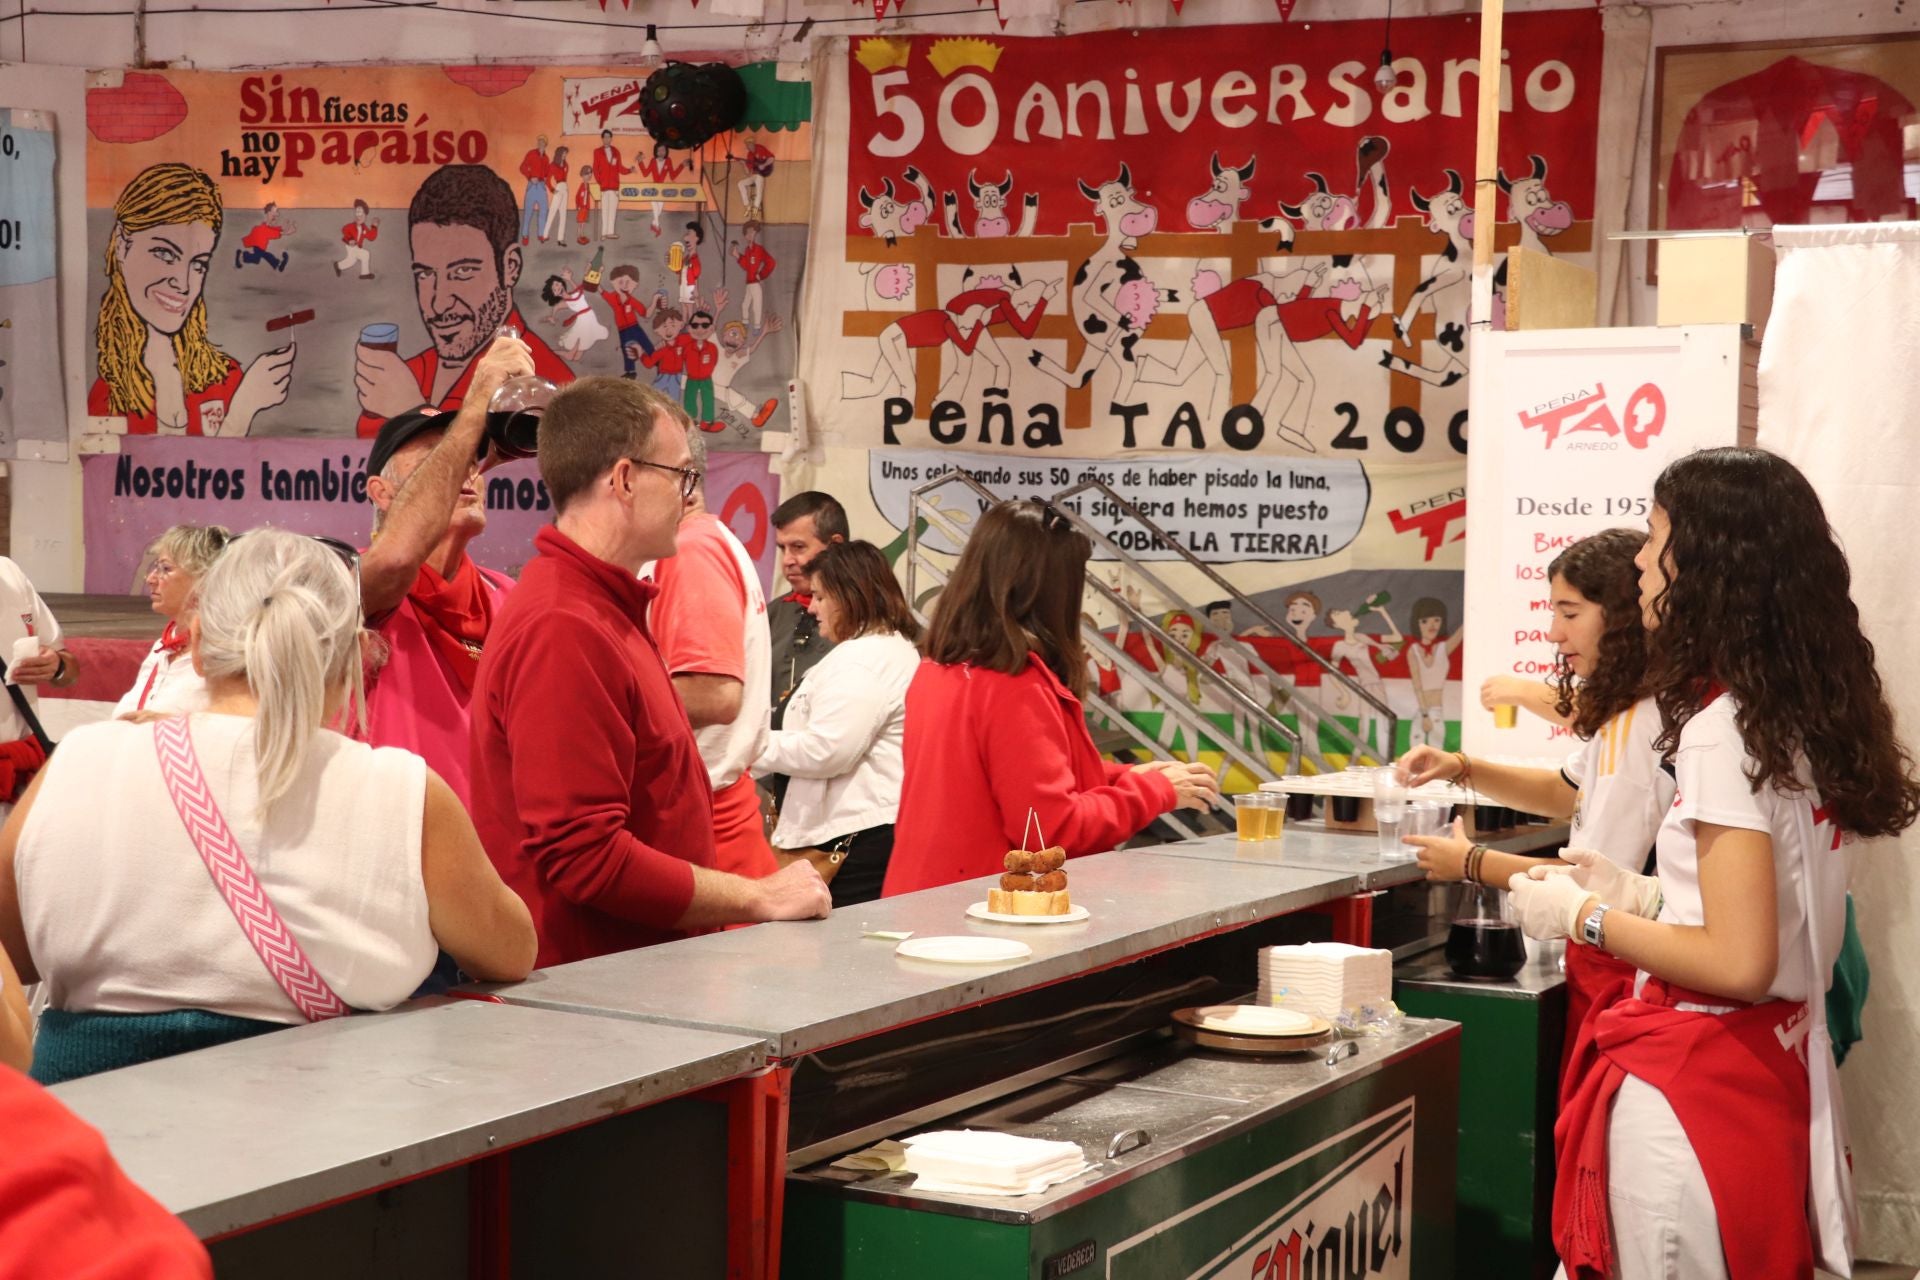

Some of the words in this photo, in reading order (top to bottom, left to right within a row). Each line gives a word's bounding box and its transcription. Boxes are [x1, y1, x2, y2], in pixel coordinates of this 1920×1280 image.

[239, 74, 323, 124] Sin
[323, 96, 409, 123] fiestas
[867, 69, 1000, 158] 50
[241, 131, 281, 153] no
[221, 149, 281, 184] hay
[1533, 388, 1591, 414] PEÑA
[1109, 401, 1265, 451] TAO
[1566, 441, 1619, 452] ARNEDO
[114, 454, 245, 500] Nosotros
[261, 455, 369, 503] tambié
[882, 461, 919, 480] Unos
[1018, 470, 1044, 486] sus
[1050, 467, 1070, 486] 50
[1077, 466, 1115, 485] años
[1122, 468, 1142, 486] de
[1149, 467, 1198, 488] haber
[1204, 468, 1259, 496] pisado
[1266, 470, 1282, 488] la
[1184, 498, 1248, 519] hemos
[1258, 500, 1329, 529] puesto
[1515, 497, 1593, 516] Desde
[1604, 497, 1653, 516] 195
[1189, 531, 1219, 552] LA
[1230, 532, 1328, 555] TIERRA!
[1533, 532, 1588, 553] Bus
